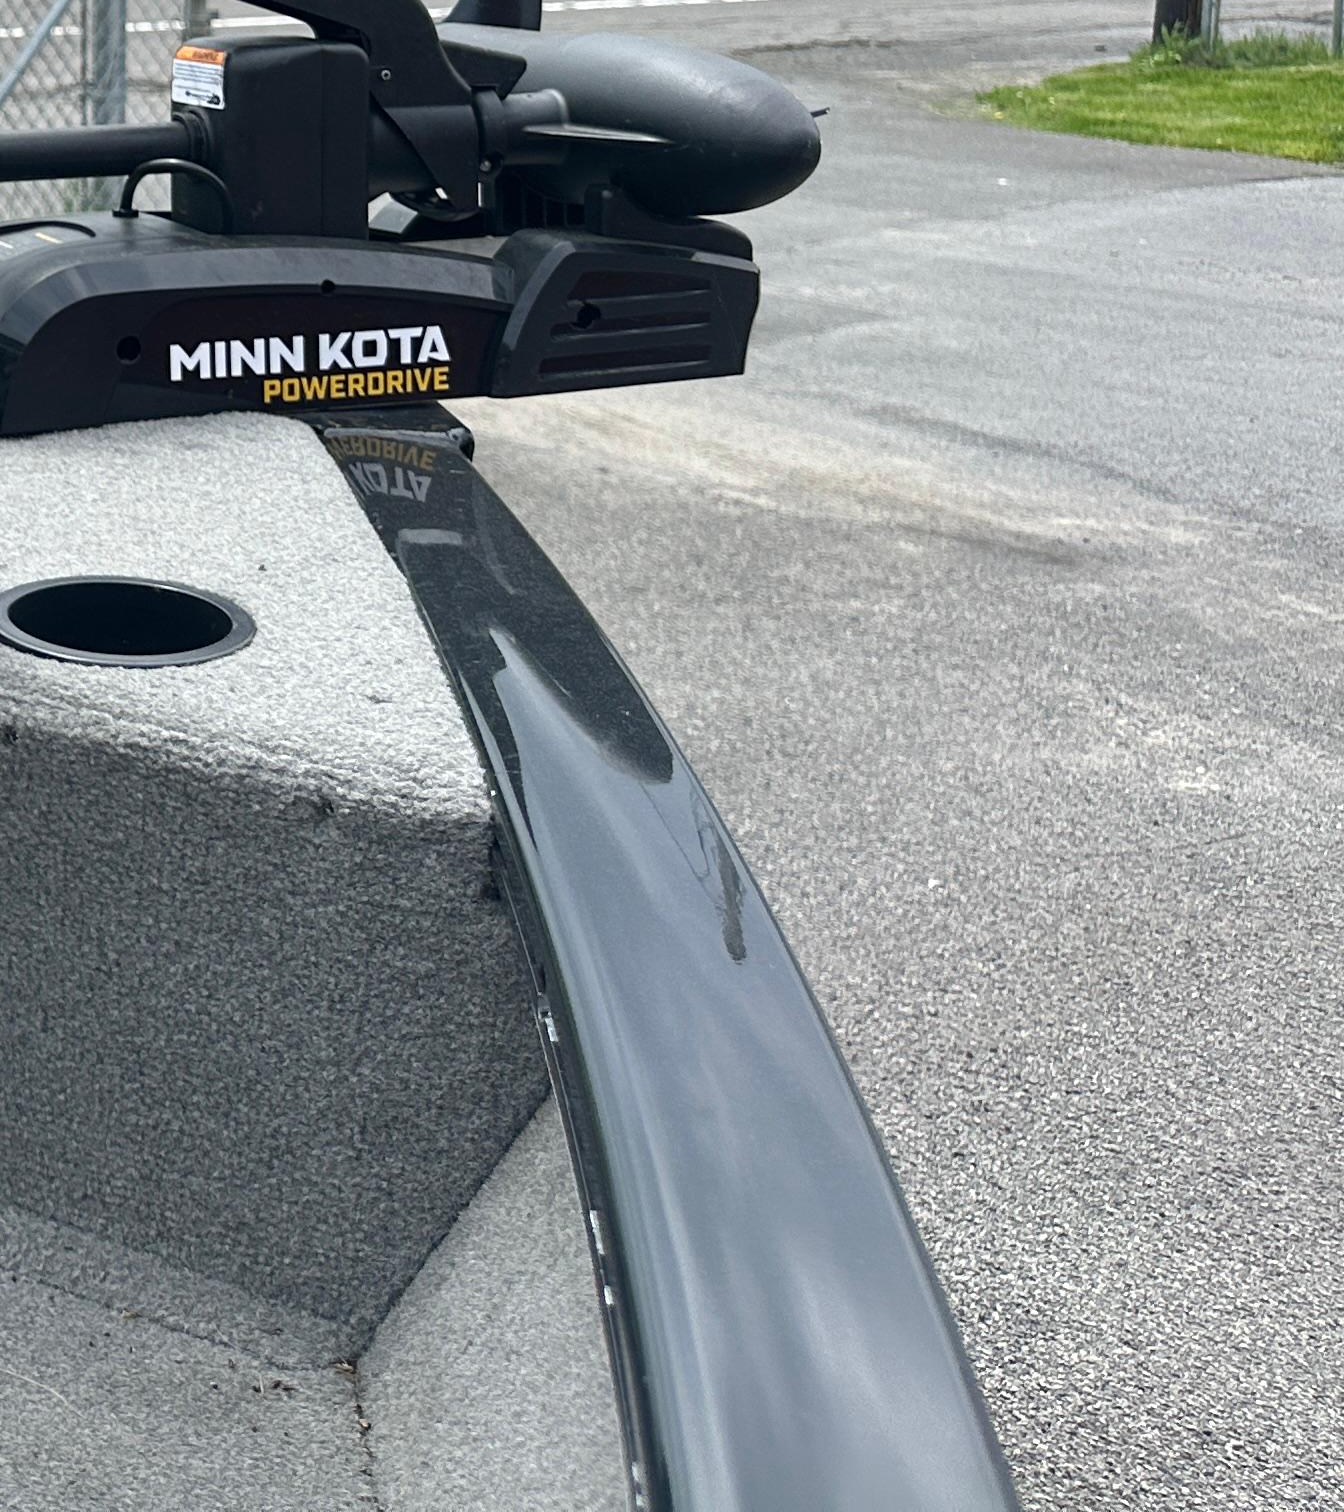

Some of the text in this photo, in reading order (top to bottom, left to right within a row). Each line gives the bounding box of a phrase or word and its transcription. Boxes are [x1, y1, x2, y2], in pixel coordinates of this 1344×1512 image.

[169, 325, 451, 382] MINN KOTA
[263, 366, 450, 404] POWERDRIVE
